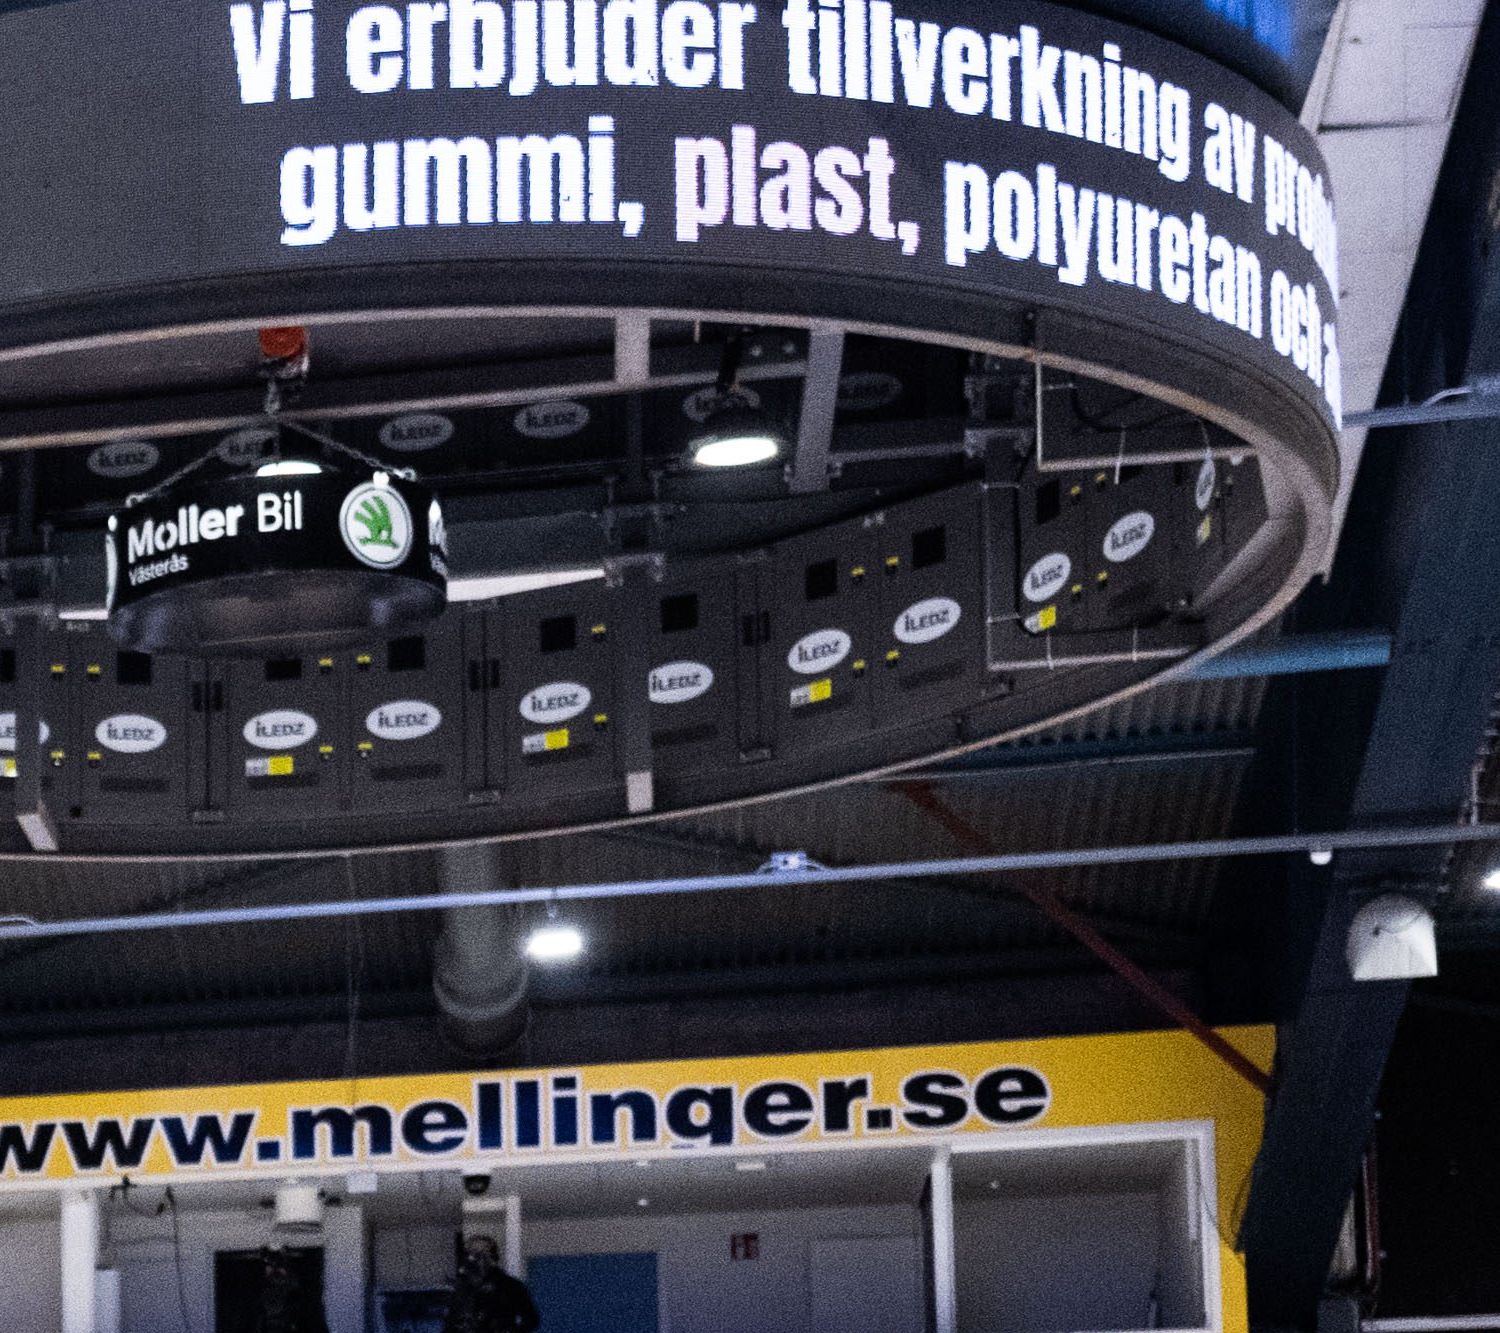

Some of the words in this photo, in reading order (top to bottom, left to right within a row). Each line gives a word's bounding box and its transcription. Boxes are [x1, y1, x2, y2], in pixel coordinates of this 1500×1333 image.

[229, 0, 317, 105] Vi
[345, 0, 759, 100] erbjuder
[783, 0, 1192, 182] tillverkning
[1203, 102, 1257, 203] av
[278, 114, 645, 249] gummi,
[673, 124, 921, 257] plast,
[943, 160, 1263, 340] polyuretan
[1269, 268, 1323, 388] och
[128, 553, 189, 588] Västerås
[257, 488, 303, 533] Bil
